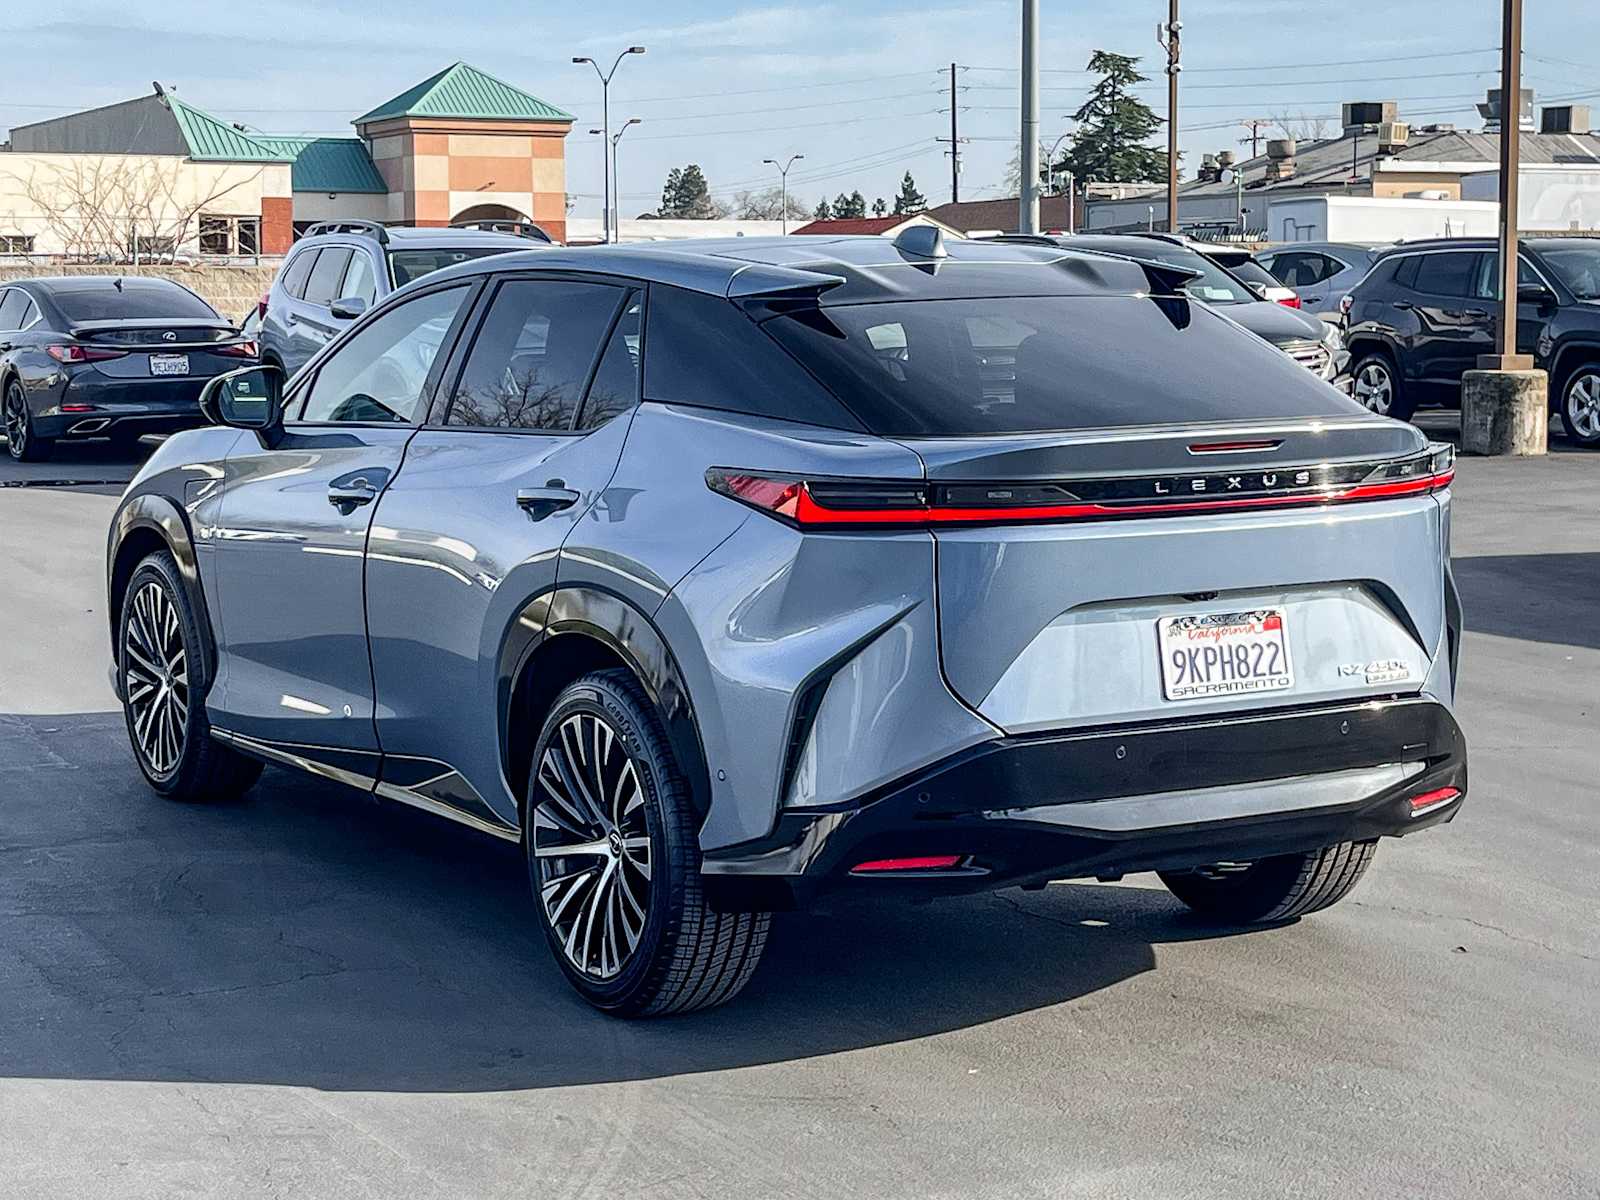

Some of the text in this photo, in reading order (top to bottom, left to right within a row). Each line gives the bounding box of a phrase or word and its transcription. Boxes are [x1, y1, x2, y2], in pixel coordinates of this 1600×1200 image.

[1155, 471, 1310, 494] LEXUS
[1187, 622, 1256, 641] California
[1172, 641, 1283, 685] 9KPH822
